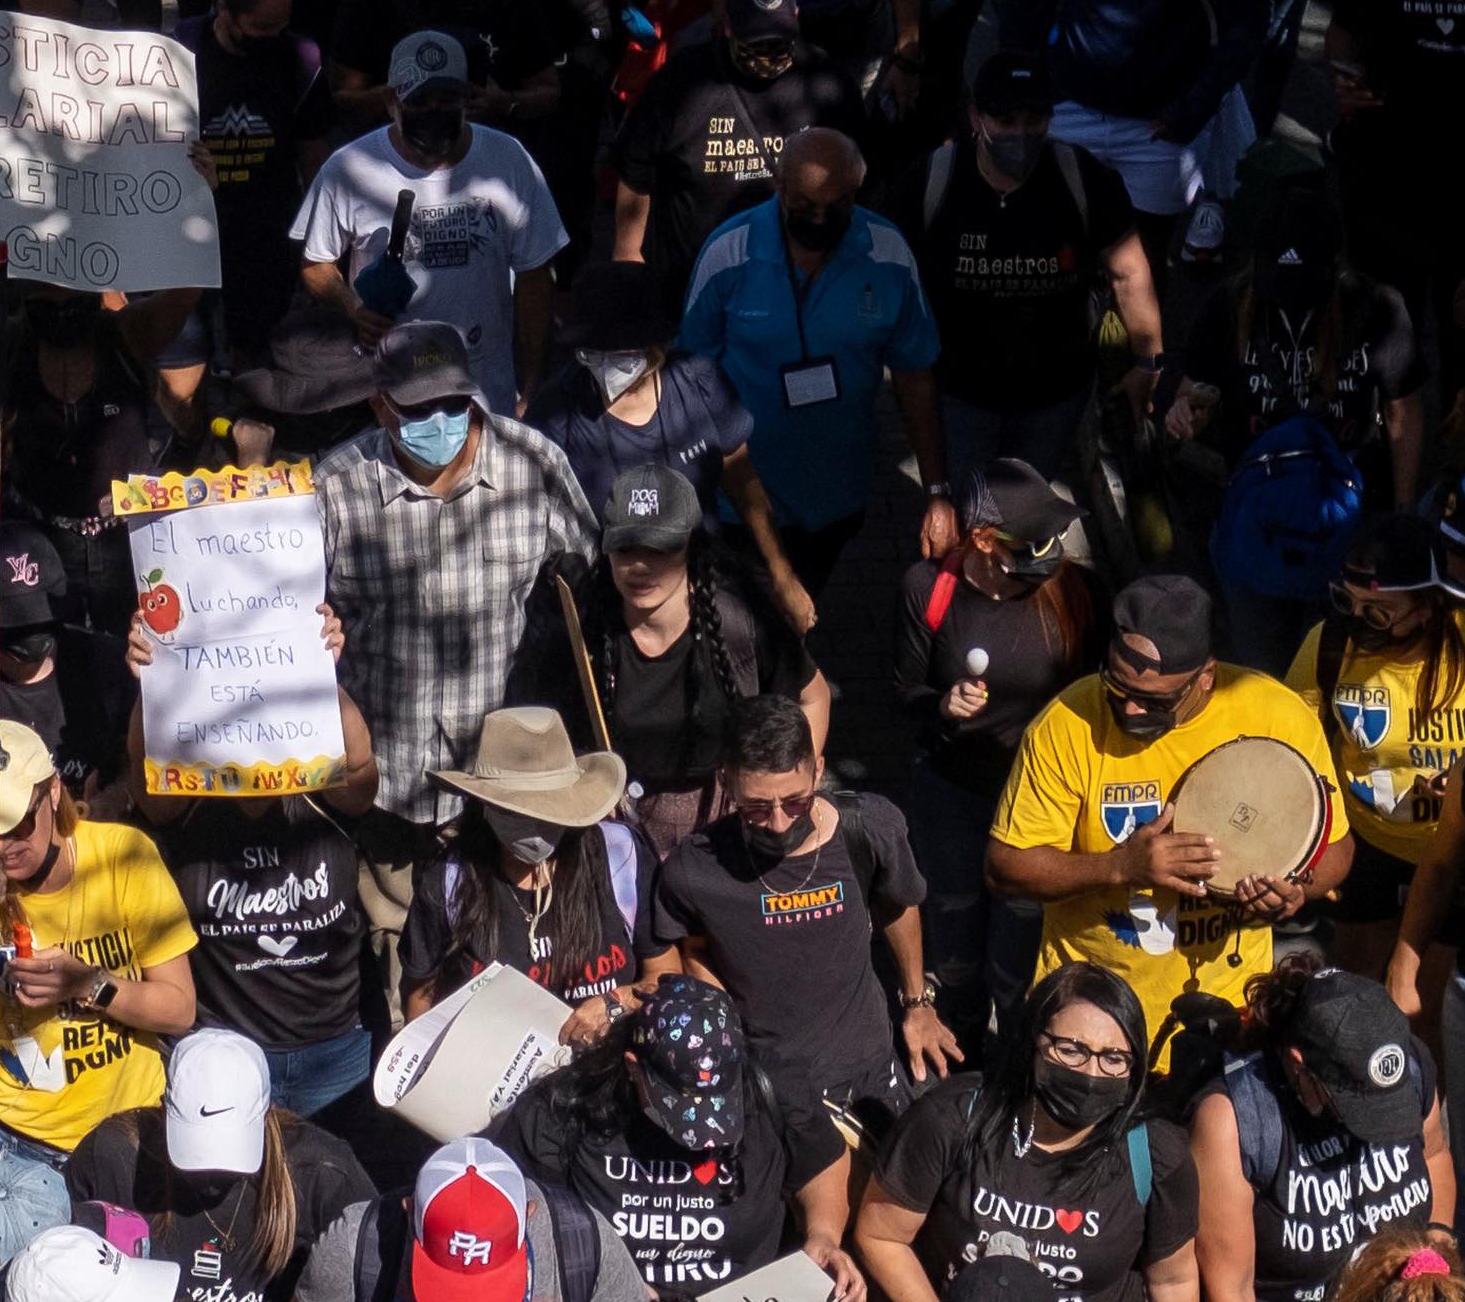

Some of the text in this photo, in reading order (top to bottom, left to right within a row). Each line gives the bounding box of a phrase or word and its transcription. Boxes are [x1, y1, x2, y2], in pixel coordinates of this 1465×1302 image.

[958, 232, 988, 251] SIN
[955, 254, 1059, 277] maestros
[631, 489, 659, 505] DOG
[150, 522, 303, 555] El maestro
[187, 581, 300, 614] luchando,
[177, 640, 296, 671] TAMBIÉN
[211, 677, 265, 704] ESTÁ
[1103, 785, 1159, 804] FMPR
[243, 846, 280, 870] SIN
[208, 863, 329, 921] Maestros
[764, 886, 842, 914] TOMMY
[764, 904, 844, 927] HILFIGER
[612, 1213, 724, 1242] SUELDO
